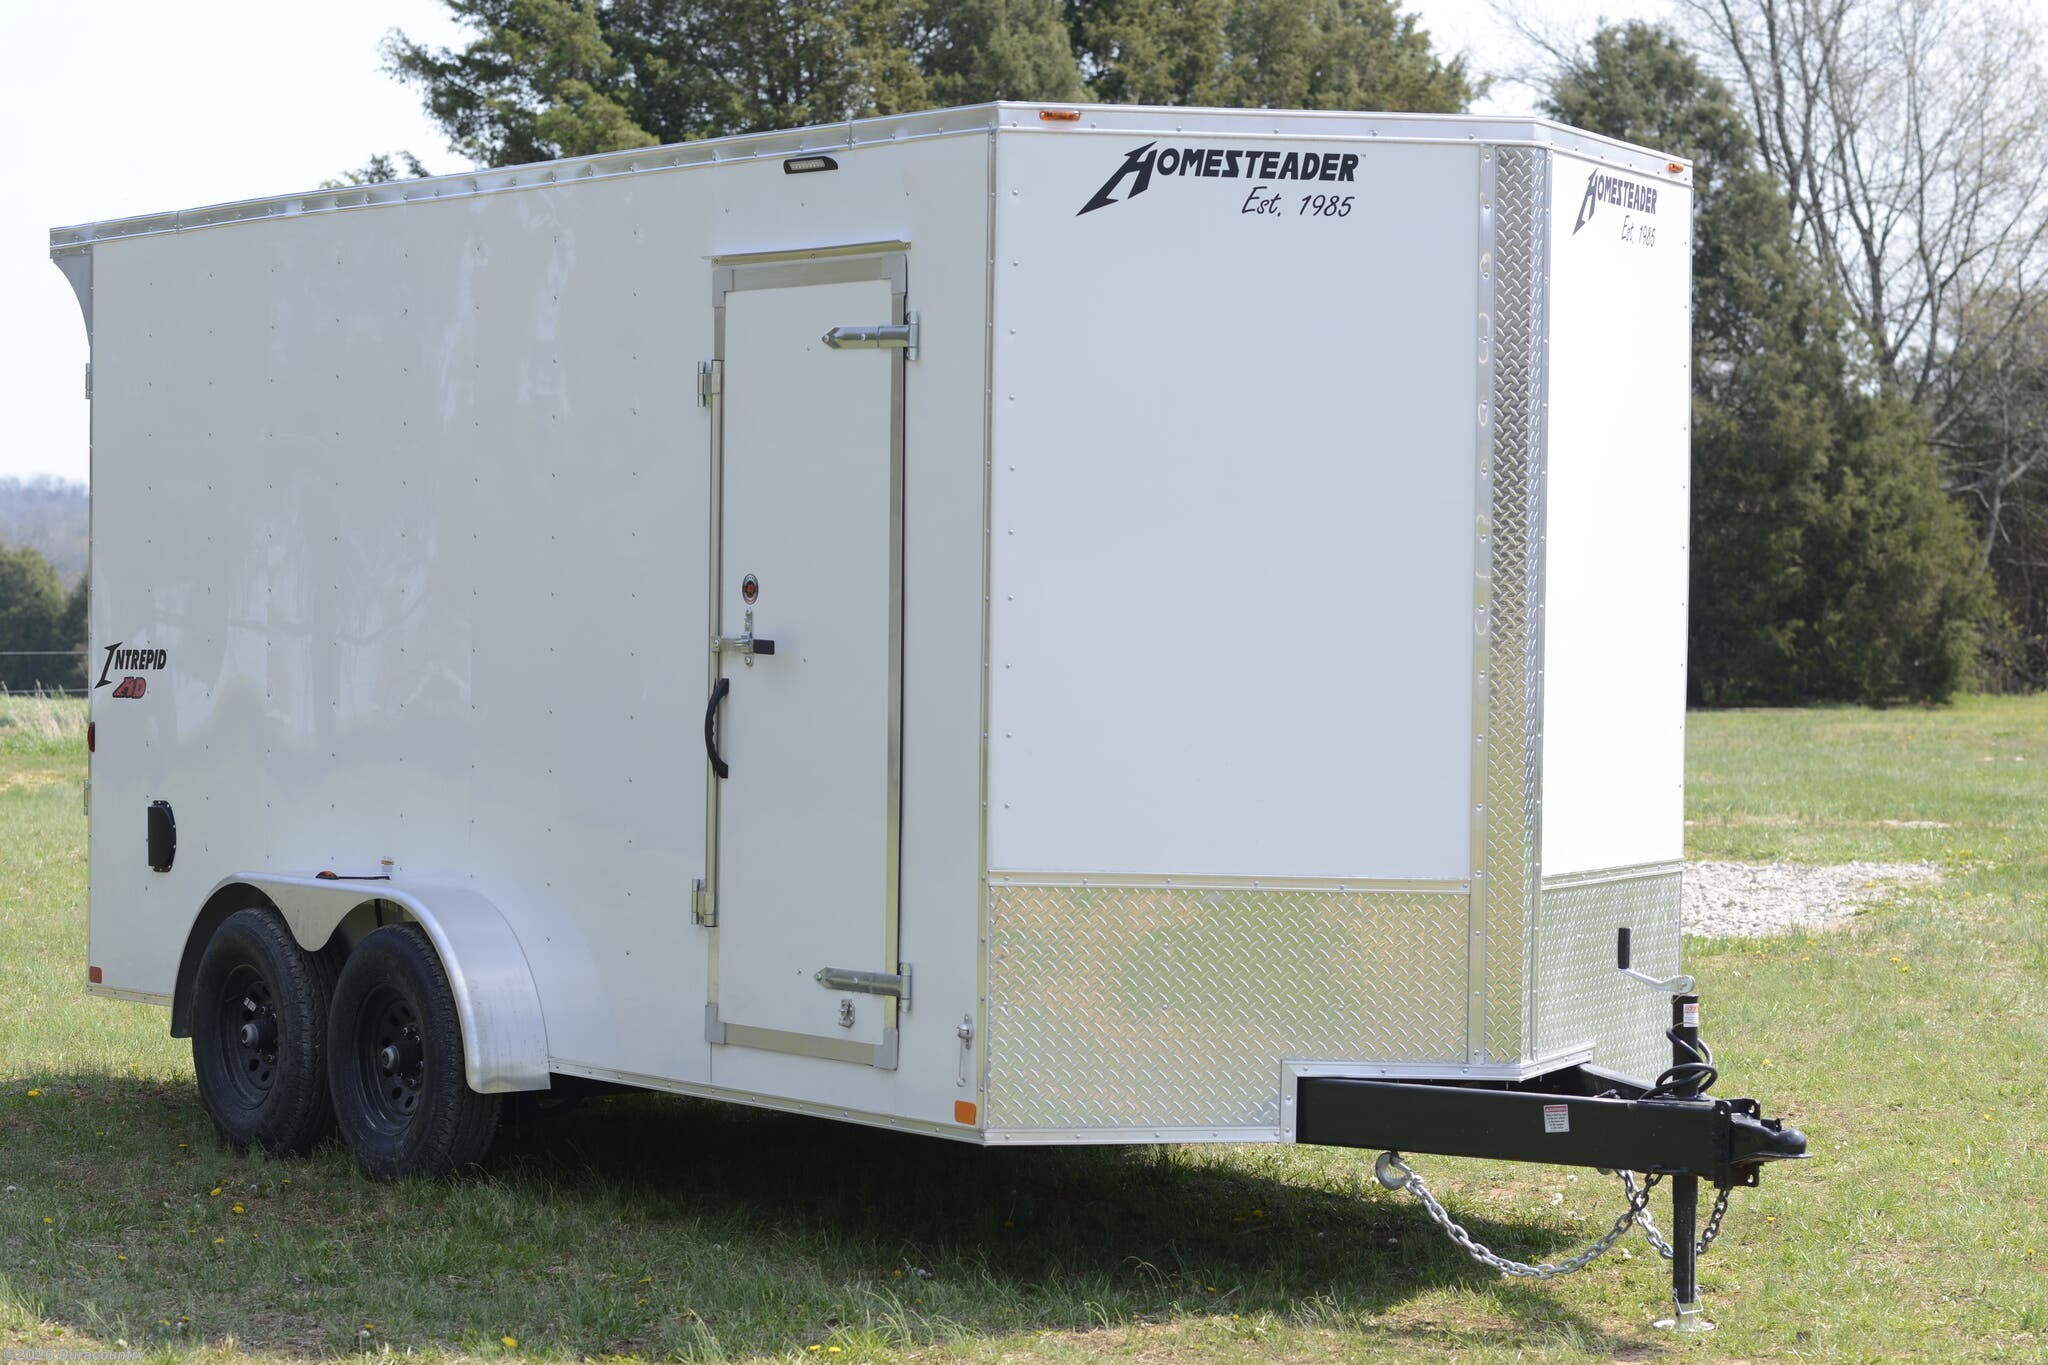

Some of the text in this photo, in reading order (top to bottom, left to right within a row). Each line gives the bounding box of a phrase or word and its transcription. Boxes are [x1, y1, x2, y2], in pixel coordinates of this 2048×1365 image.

[1076, 140, 1359, 216] HOMESTEADER
[1241, 186, 1355, 217] Est. 1985
[1572, 167, 1658, 236] HOMESTEADER
[1638, 225, 1656, 247] 1985
[94, 641, 167, 689] INTREPID
